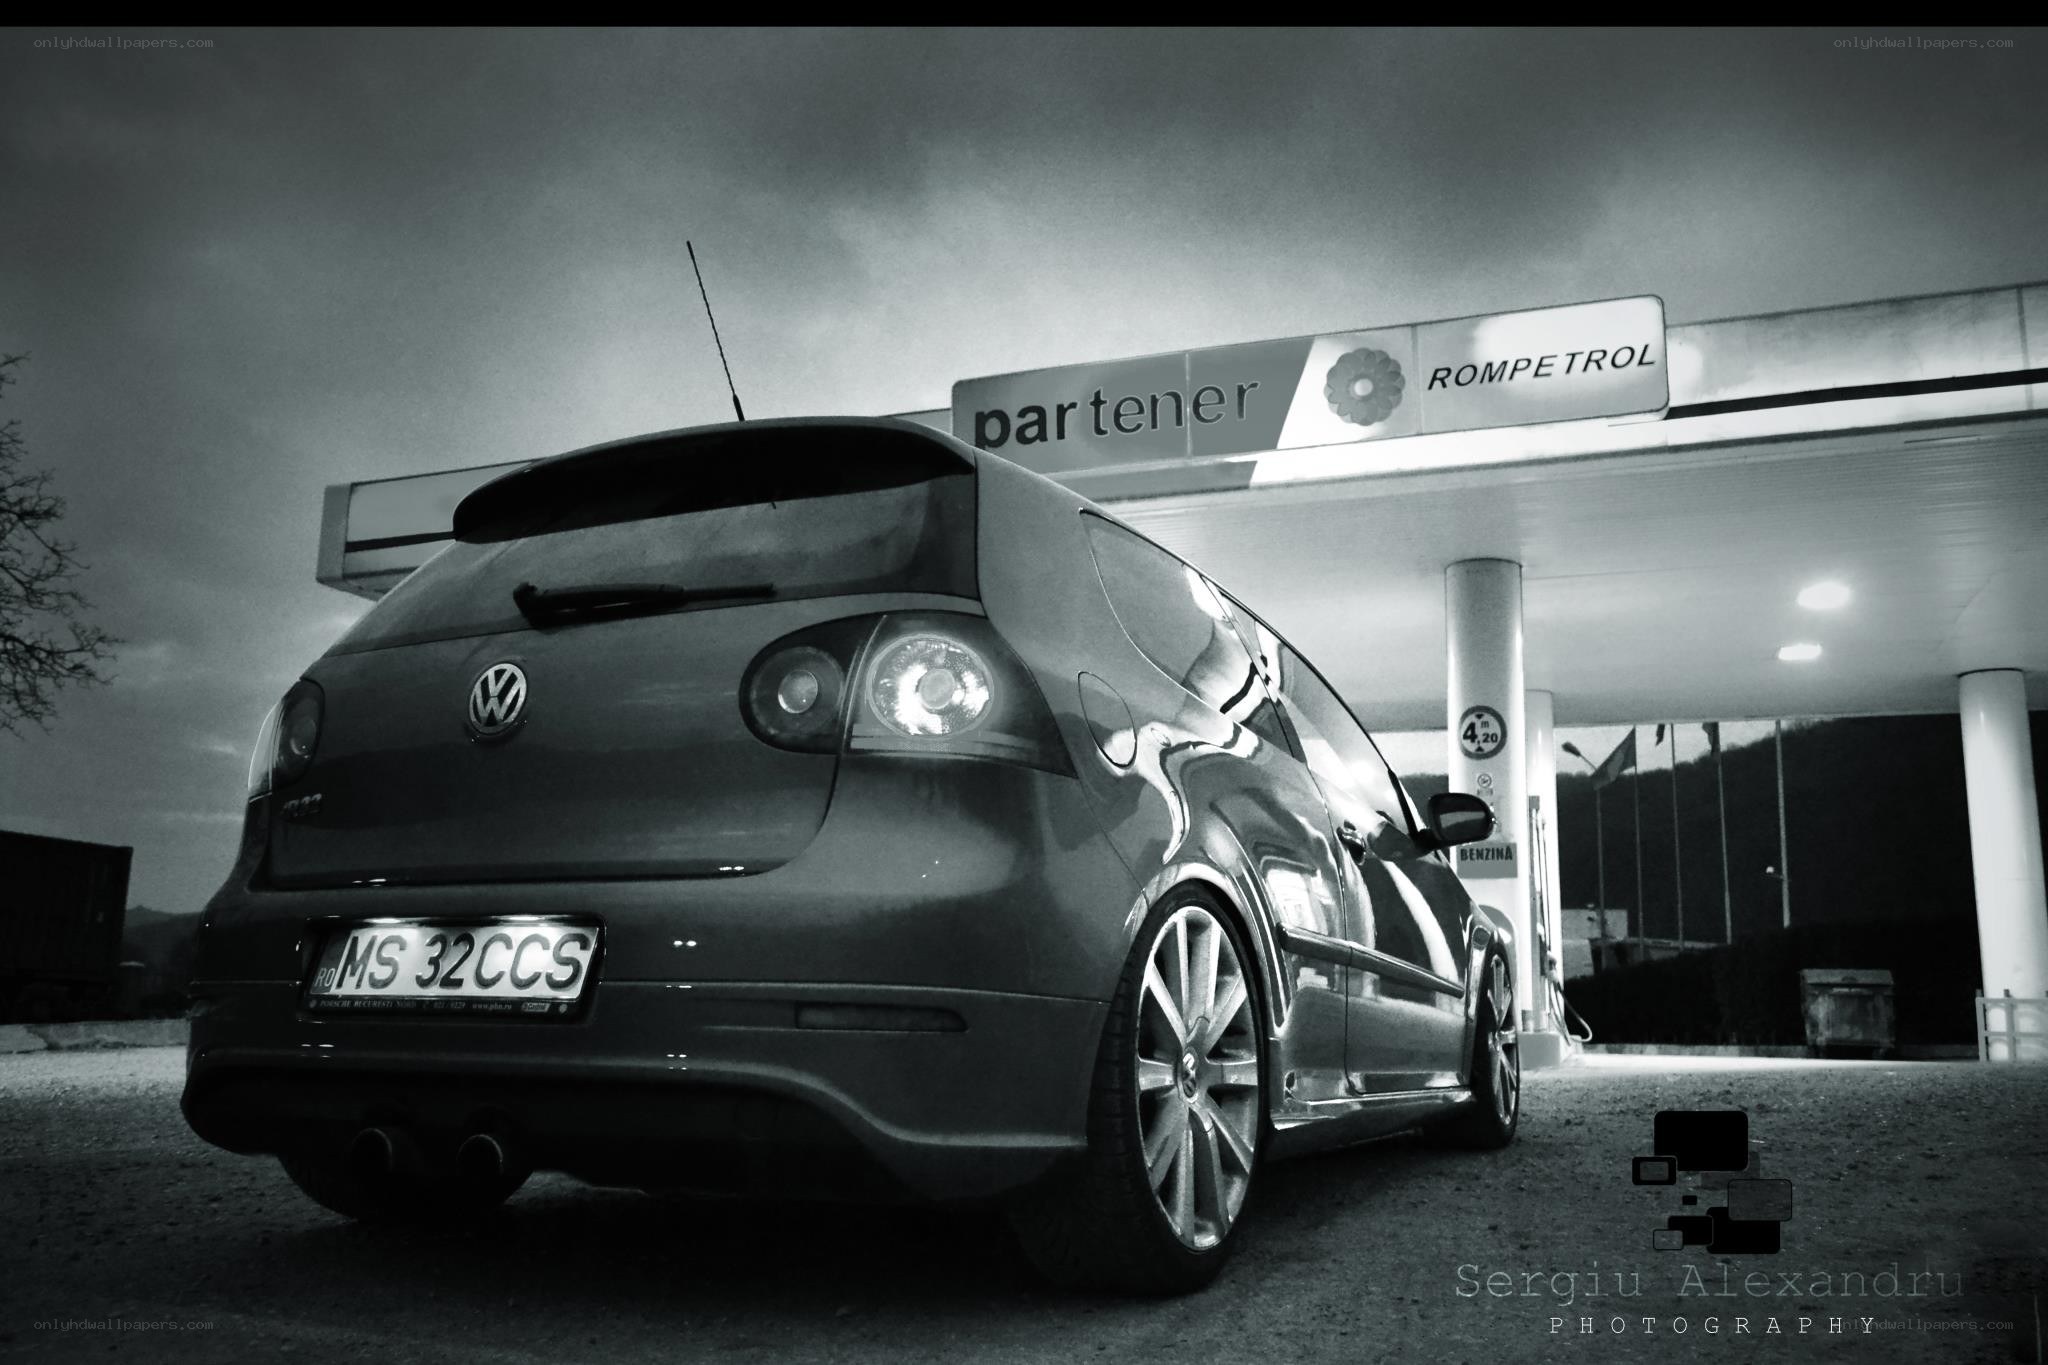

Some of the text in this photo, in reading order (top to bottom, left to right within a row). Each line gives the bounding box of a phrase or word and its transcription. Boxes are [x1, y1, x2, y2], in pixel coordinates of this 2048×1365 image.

[1427, 343, 1656, 391] ROMPETROL
[975, 381, 1260, 450] partener
[336, 934, 408, 990] MS
